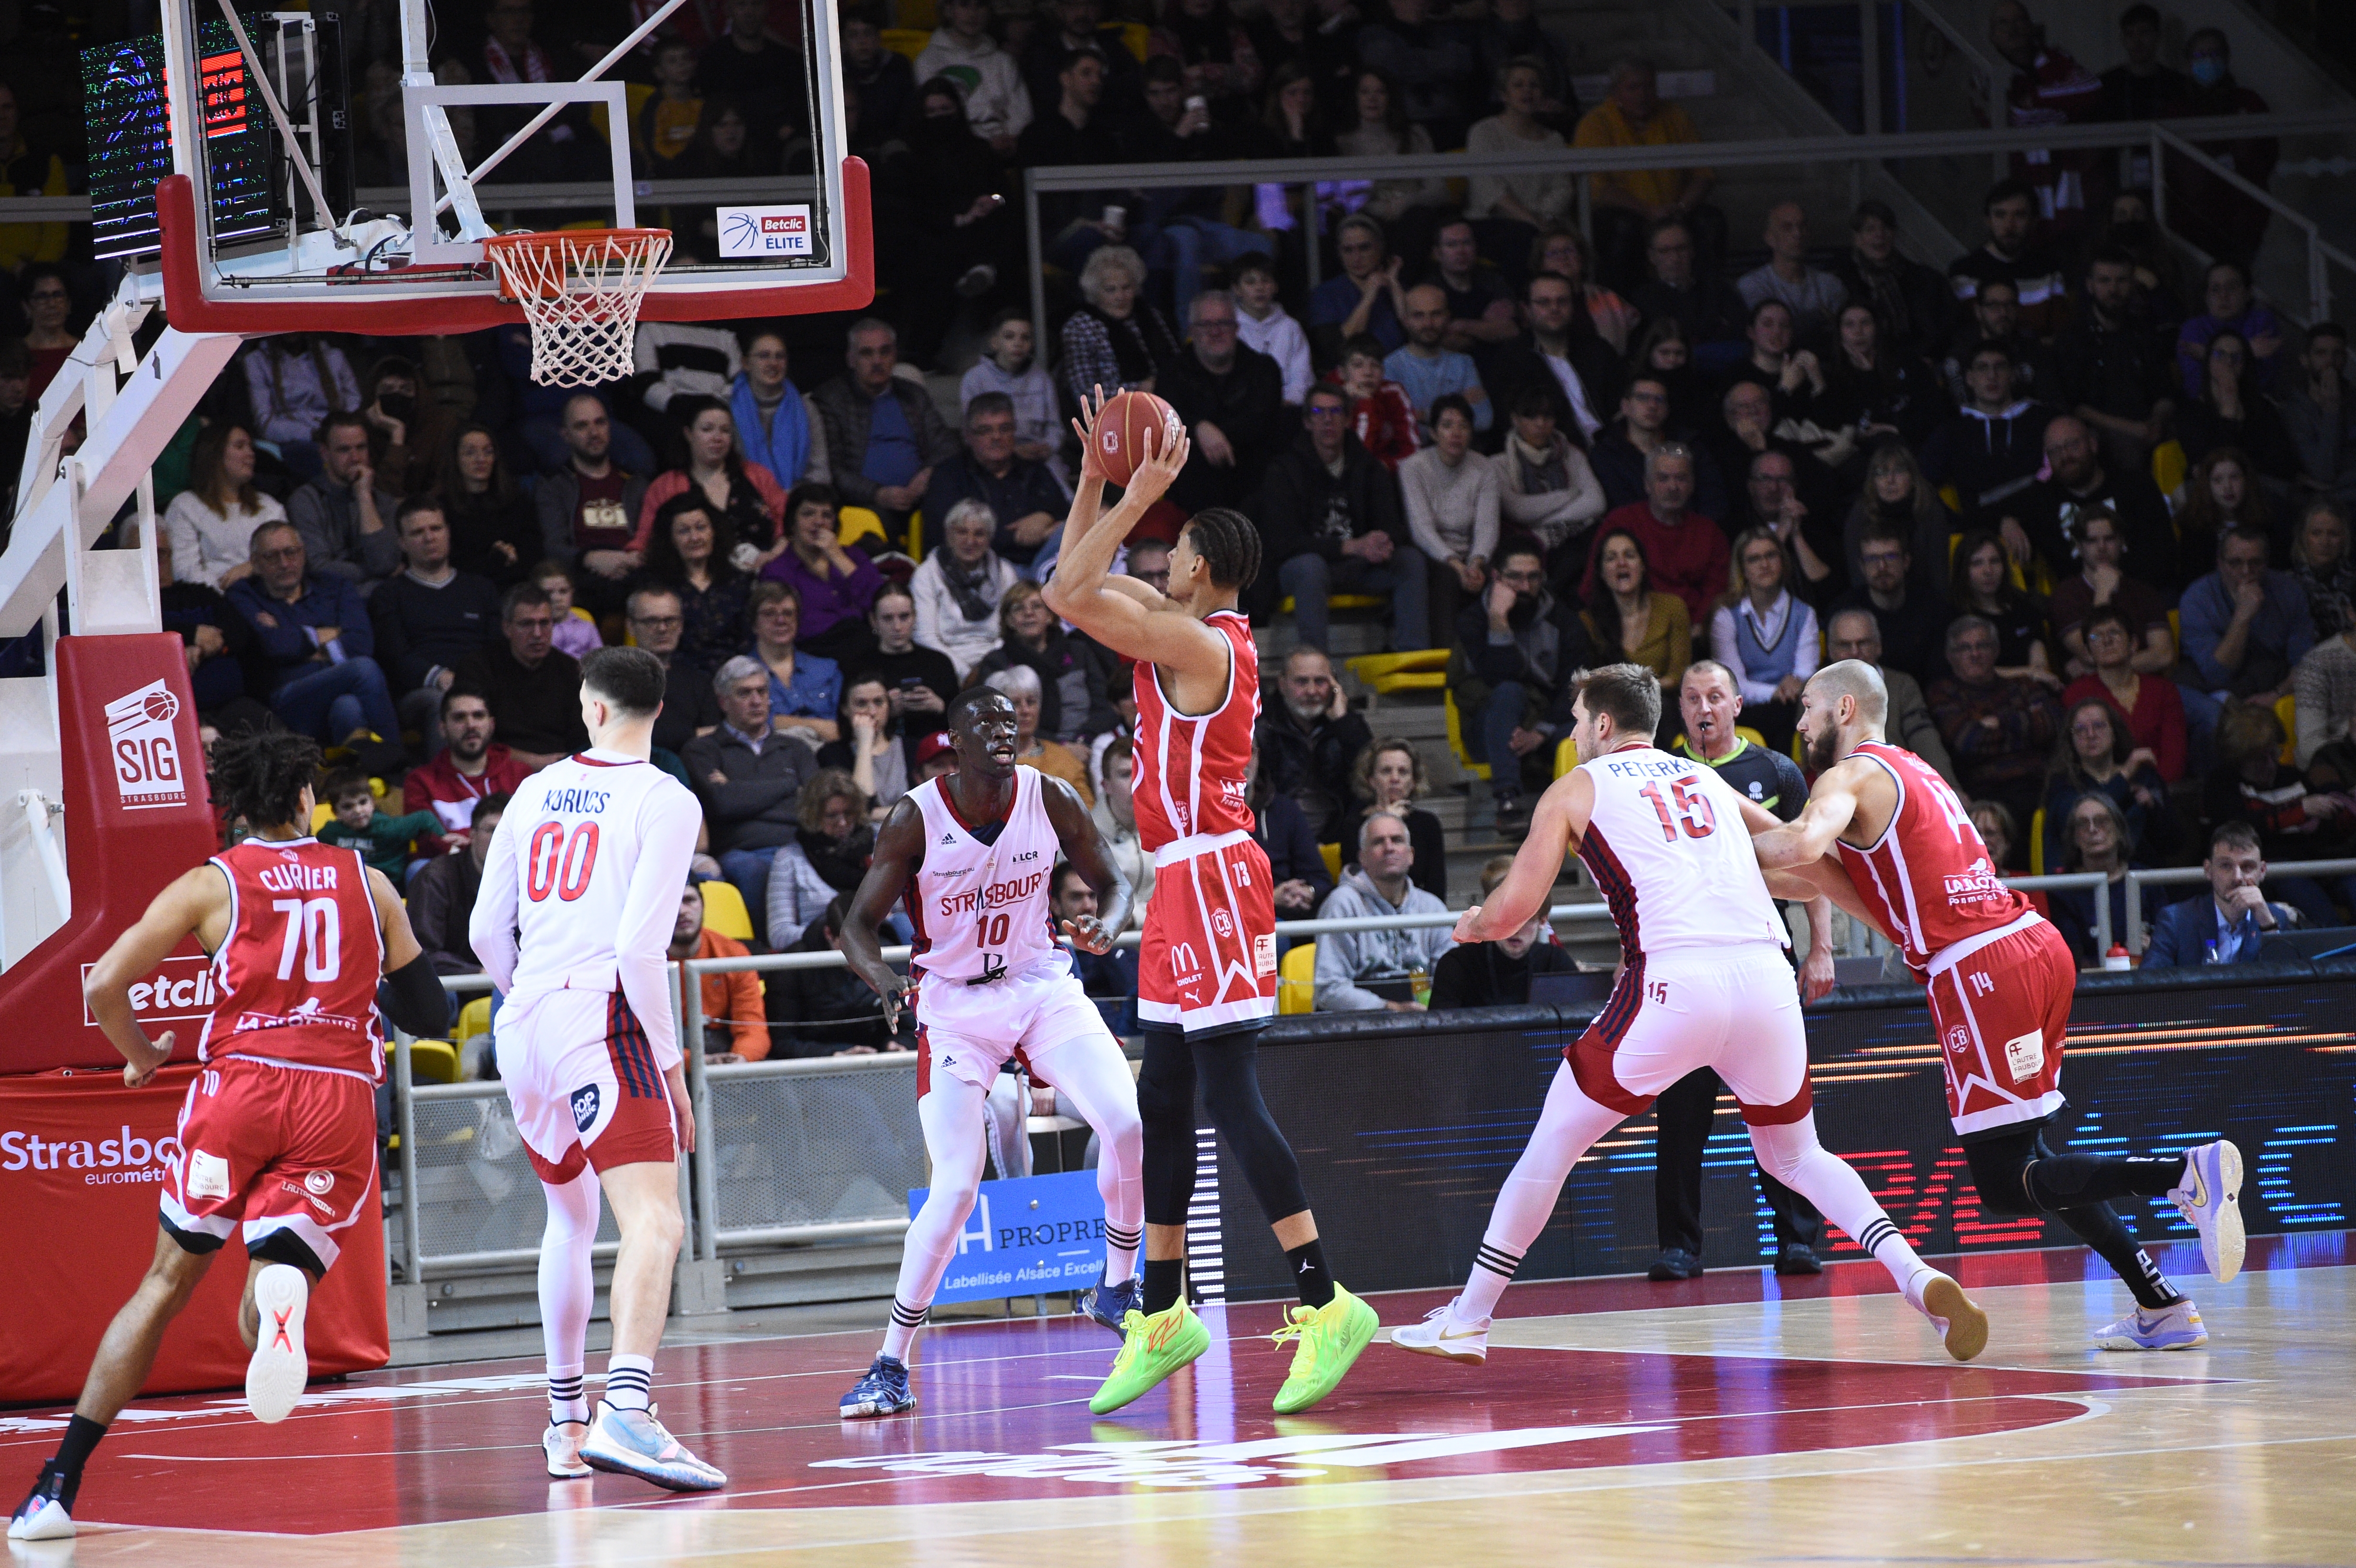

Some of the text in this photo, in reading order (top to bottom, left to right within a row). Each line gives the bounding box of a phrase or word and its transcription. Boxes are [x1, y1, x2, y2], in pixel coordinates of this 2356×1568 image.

[765, 218, 802, 230] Betclic
[766, 235, 804, 249] ÉLITE
[117, 737, 177, 783] SIG
[1608, 759, 1700, 777] PETERKA
[120, 792, 186, 804] STRASBOURG
[541, 789, 610, 814] KURUCS
[1639, 774, 1716, 842] 15
[528, 821, 600, 903] 00
[1020, 850, 1038, 861] LCR
[259, 863, 337, 891] CURIER
[933, 867, 975, 877] Strasbourg.eu
[1232, 861, 1251, 888] 13
[977, 913, 1010, 948] 10
[1215, 914, 1232, 933] CB
[273, 897, 340, 982] 70
[128, 968, 215, 1010] etcli
[1177, 973, 1202, 986] CHOLET
[1969, 971, 1995, 997] 14
[1648, 981, 1669, 1004] 15
[1950, 1029, 1968, 1049] CB
[2012, 1053, 2037, 1066] L'AUTRE
[0, 1125, 177, 1171] Strasbo
[85, 1165, 166, 1185] euromét
[999, 1218, 1106, 1249] PROPRE
[944, 1259, 1105, 1290] Labellisée Alsace Excell
